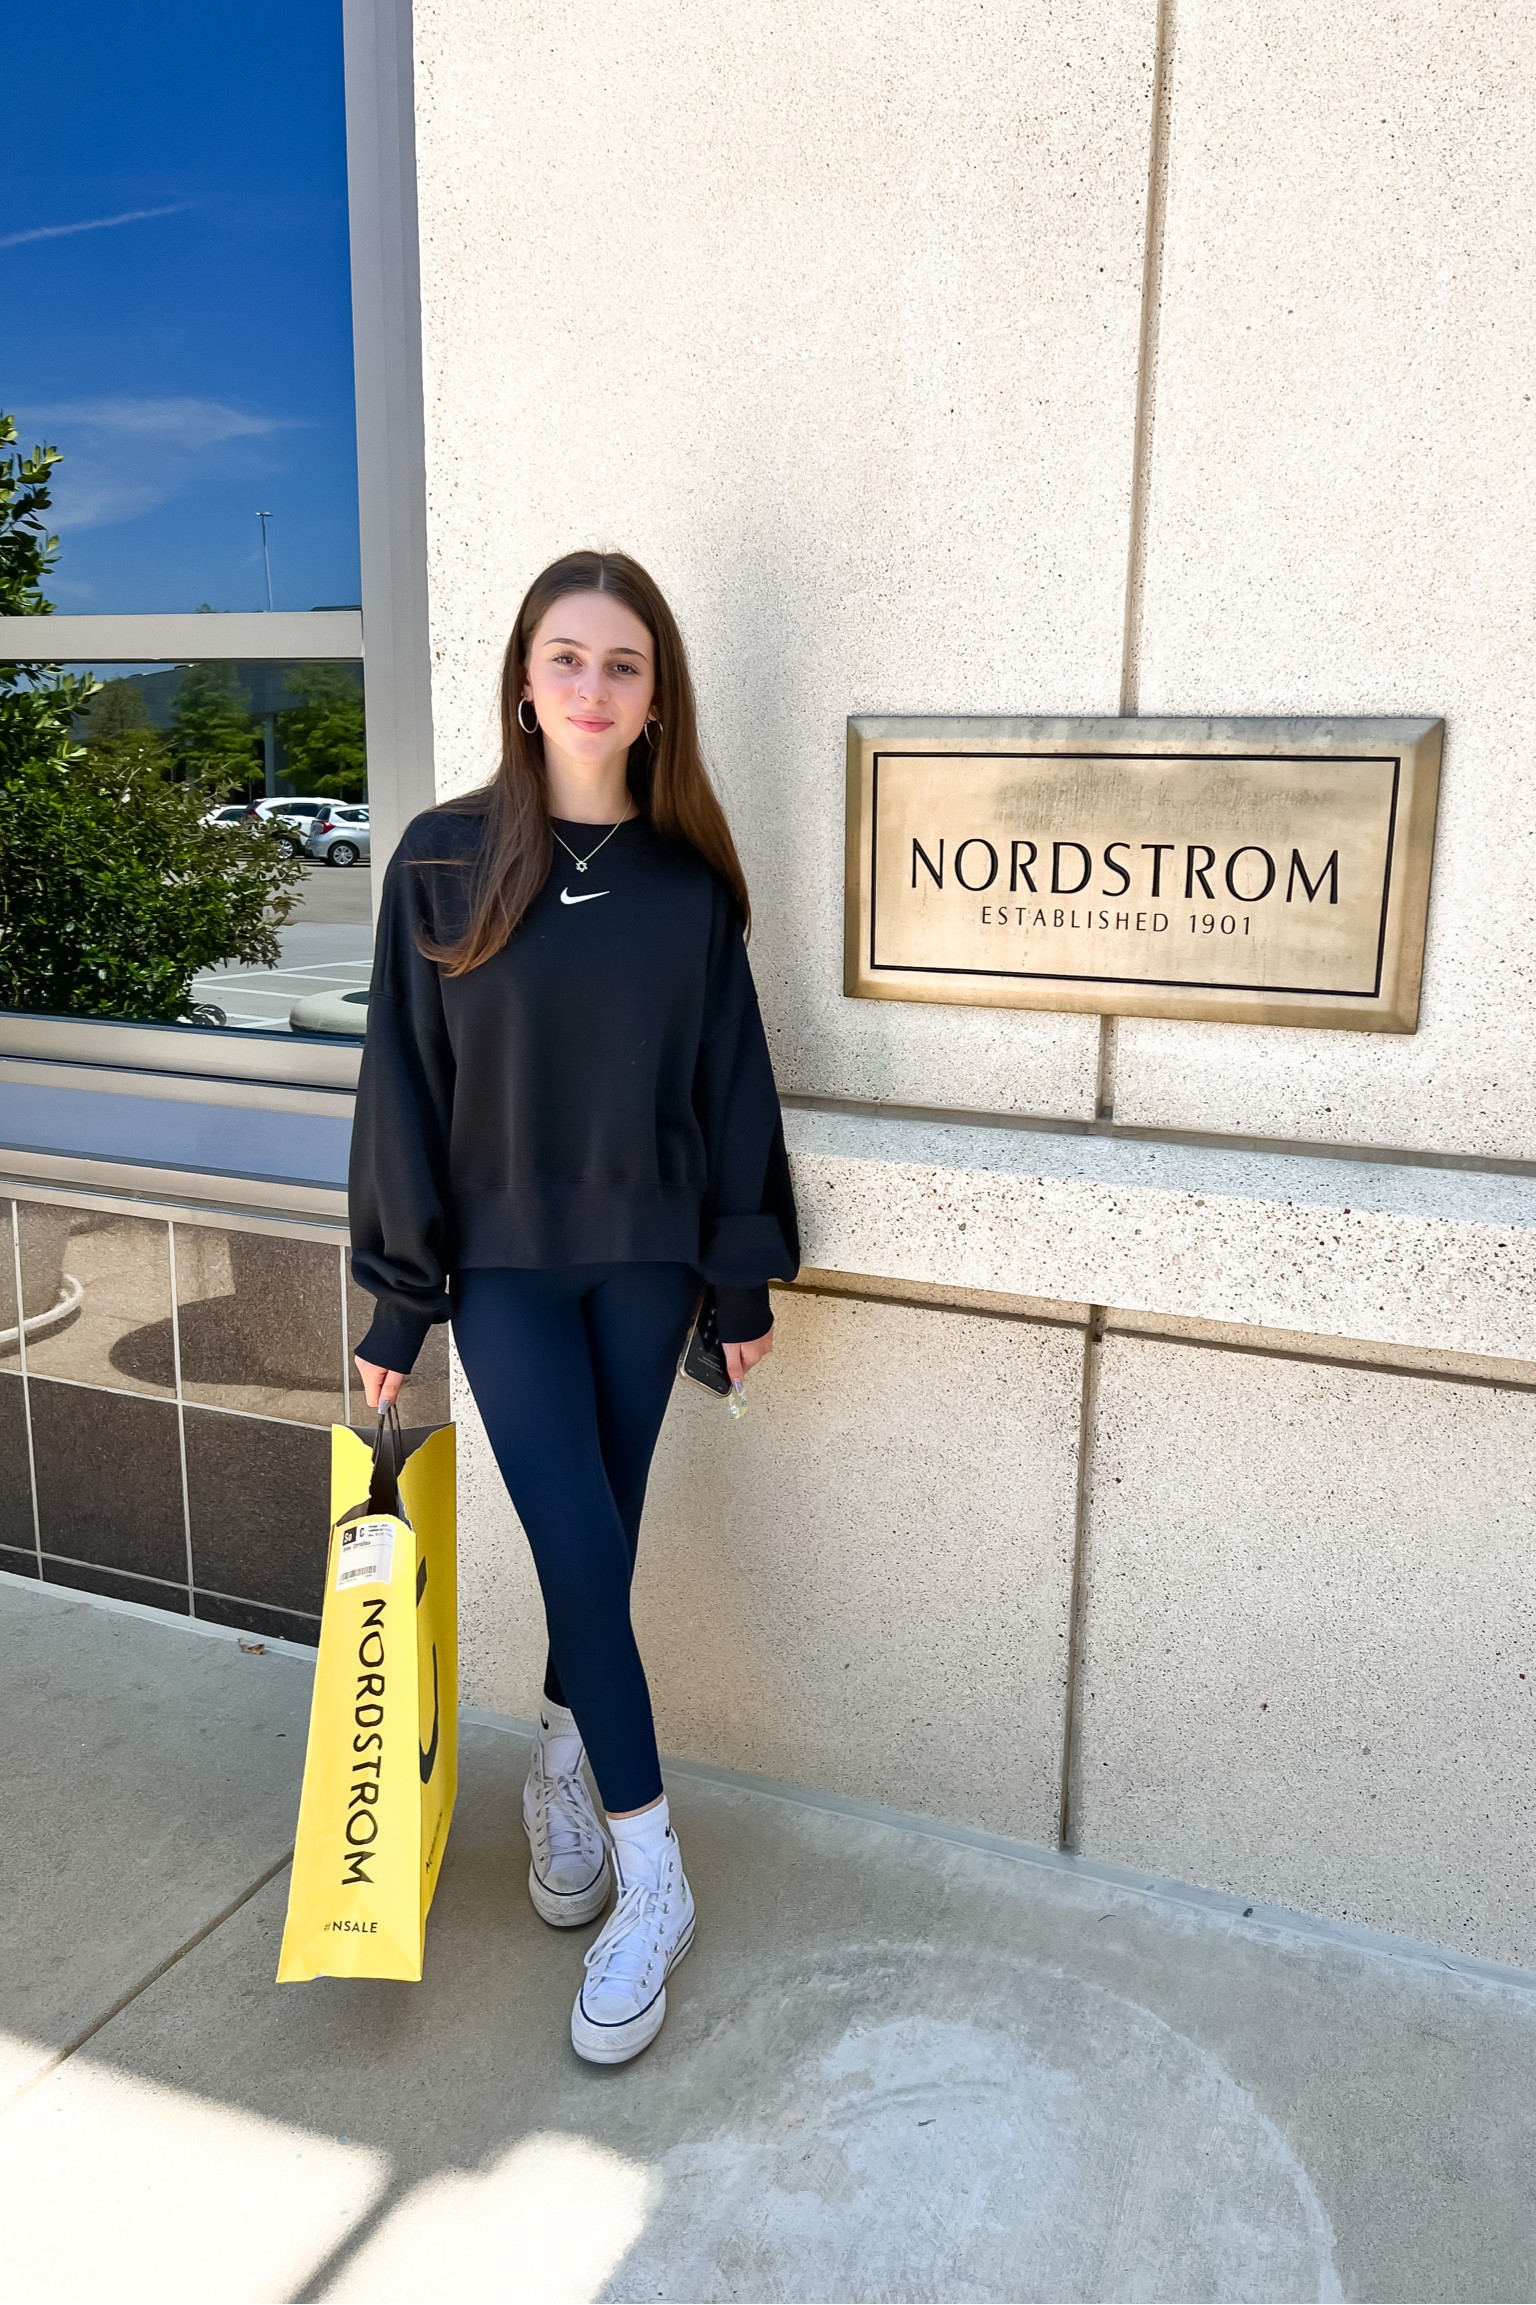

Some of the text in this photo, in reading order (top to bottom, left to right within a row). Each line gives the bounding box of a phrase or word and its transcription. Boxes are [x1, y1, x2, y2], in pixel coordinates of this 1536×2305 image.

[911, 837, 1339, 905] NORDSTROM
[982, 906, 1251, 936] ESTABLISHED 1901
[341, 1598, 387, 1886] NORDSTROM
[323, 1921, 378, 1933] #NSALE
